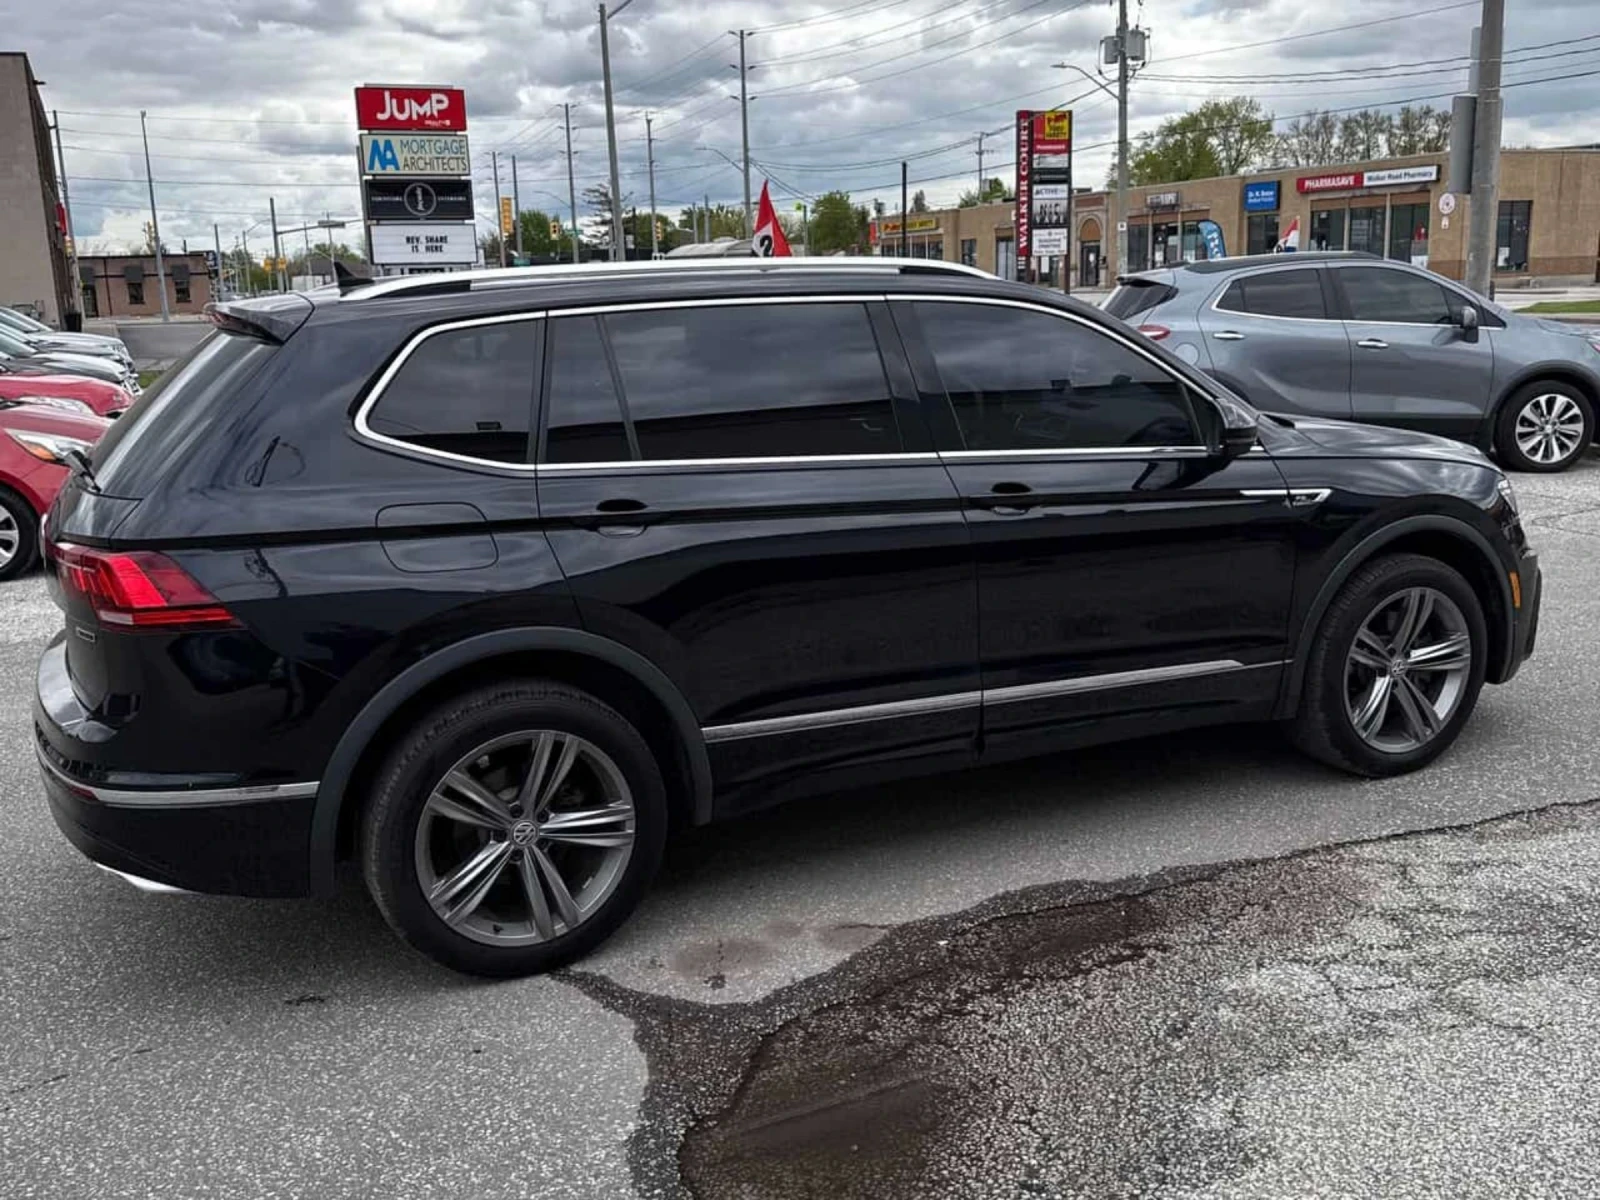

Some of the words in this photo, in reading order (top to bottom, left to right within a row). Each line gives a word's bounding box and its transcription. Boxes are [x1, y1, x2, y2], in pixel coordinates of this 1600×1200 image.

[376, 90, 449, 121] JUMP
[400, 138, 466, 155] MORTGAGE
[1020, 119, 1029, 176] COURT
[403, 156, 467, 172] ARCHITECTS
[1304, 175, 1355, 189] PHARMASAVE
[1020, 180, 1029, 248] WALKER
[425, 235, 448, 244] SHARE
[411, 245, 419, 253] IS
[425, 245, 444, 253] HERE
